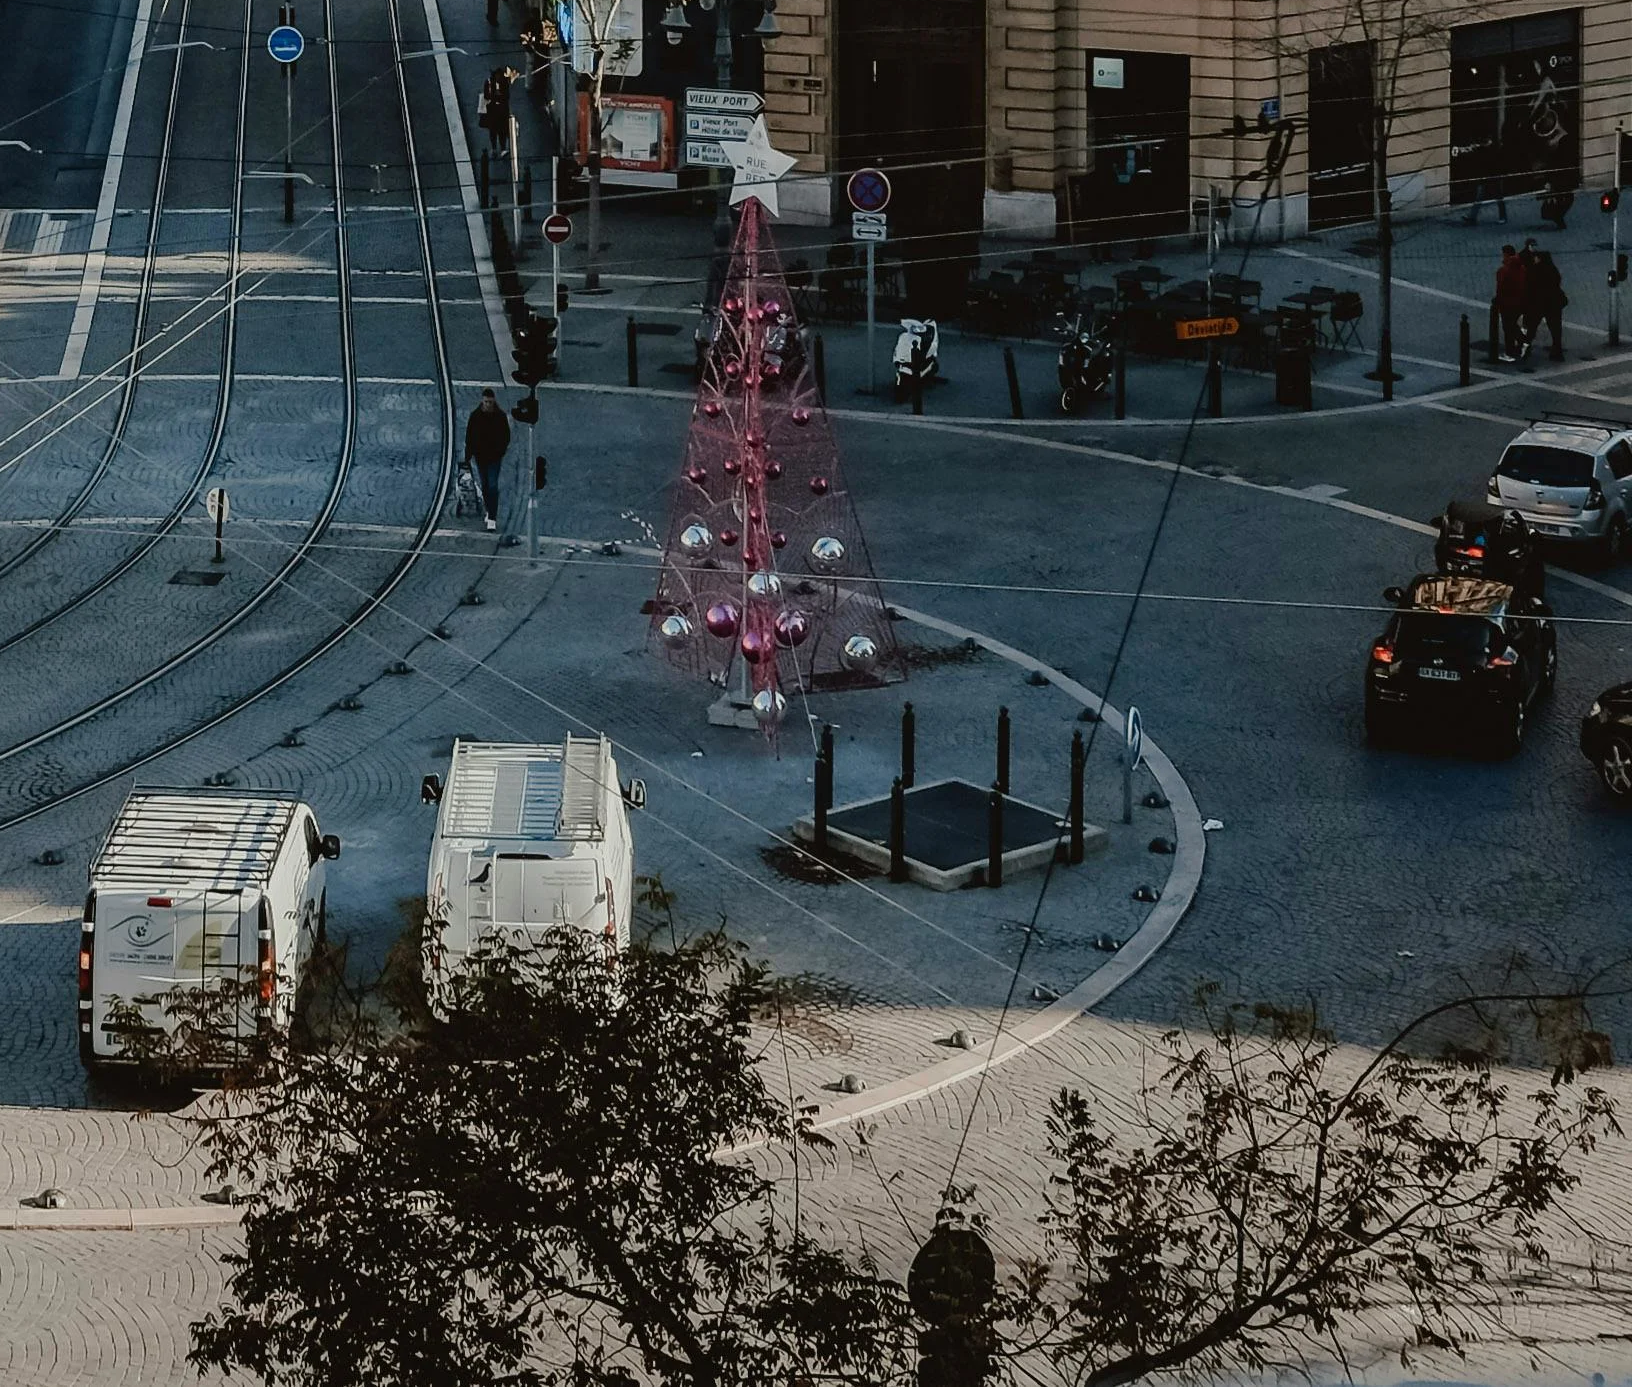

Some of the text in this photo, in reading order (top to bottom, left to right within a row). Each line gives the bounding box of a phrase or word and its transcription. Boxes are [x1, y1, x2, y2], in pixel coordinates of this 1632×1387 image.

[689, 94, 749, 107] VIEUX PORT
[746, 156, 767, 170] RUE
